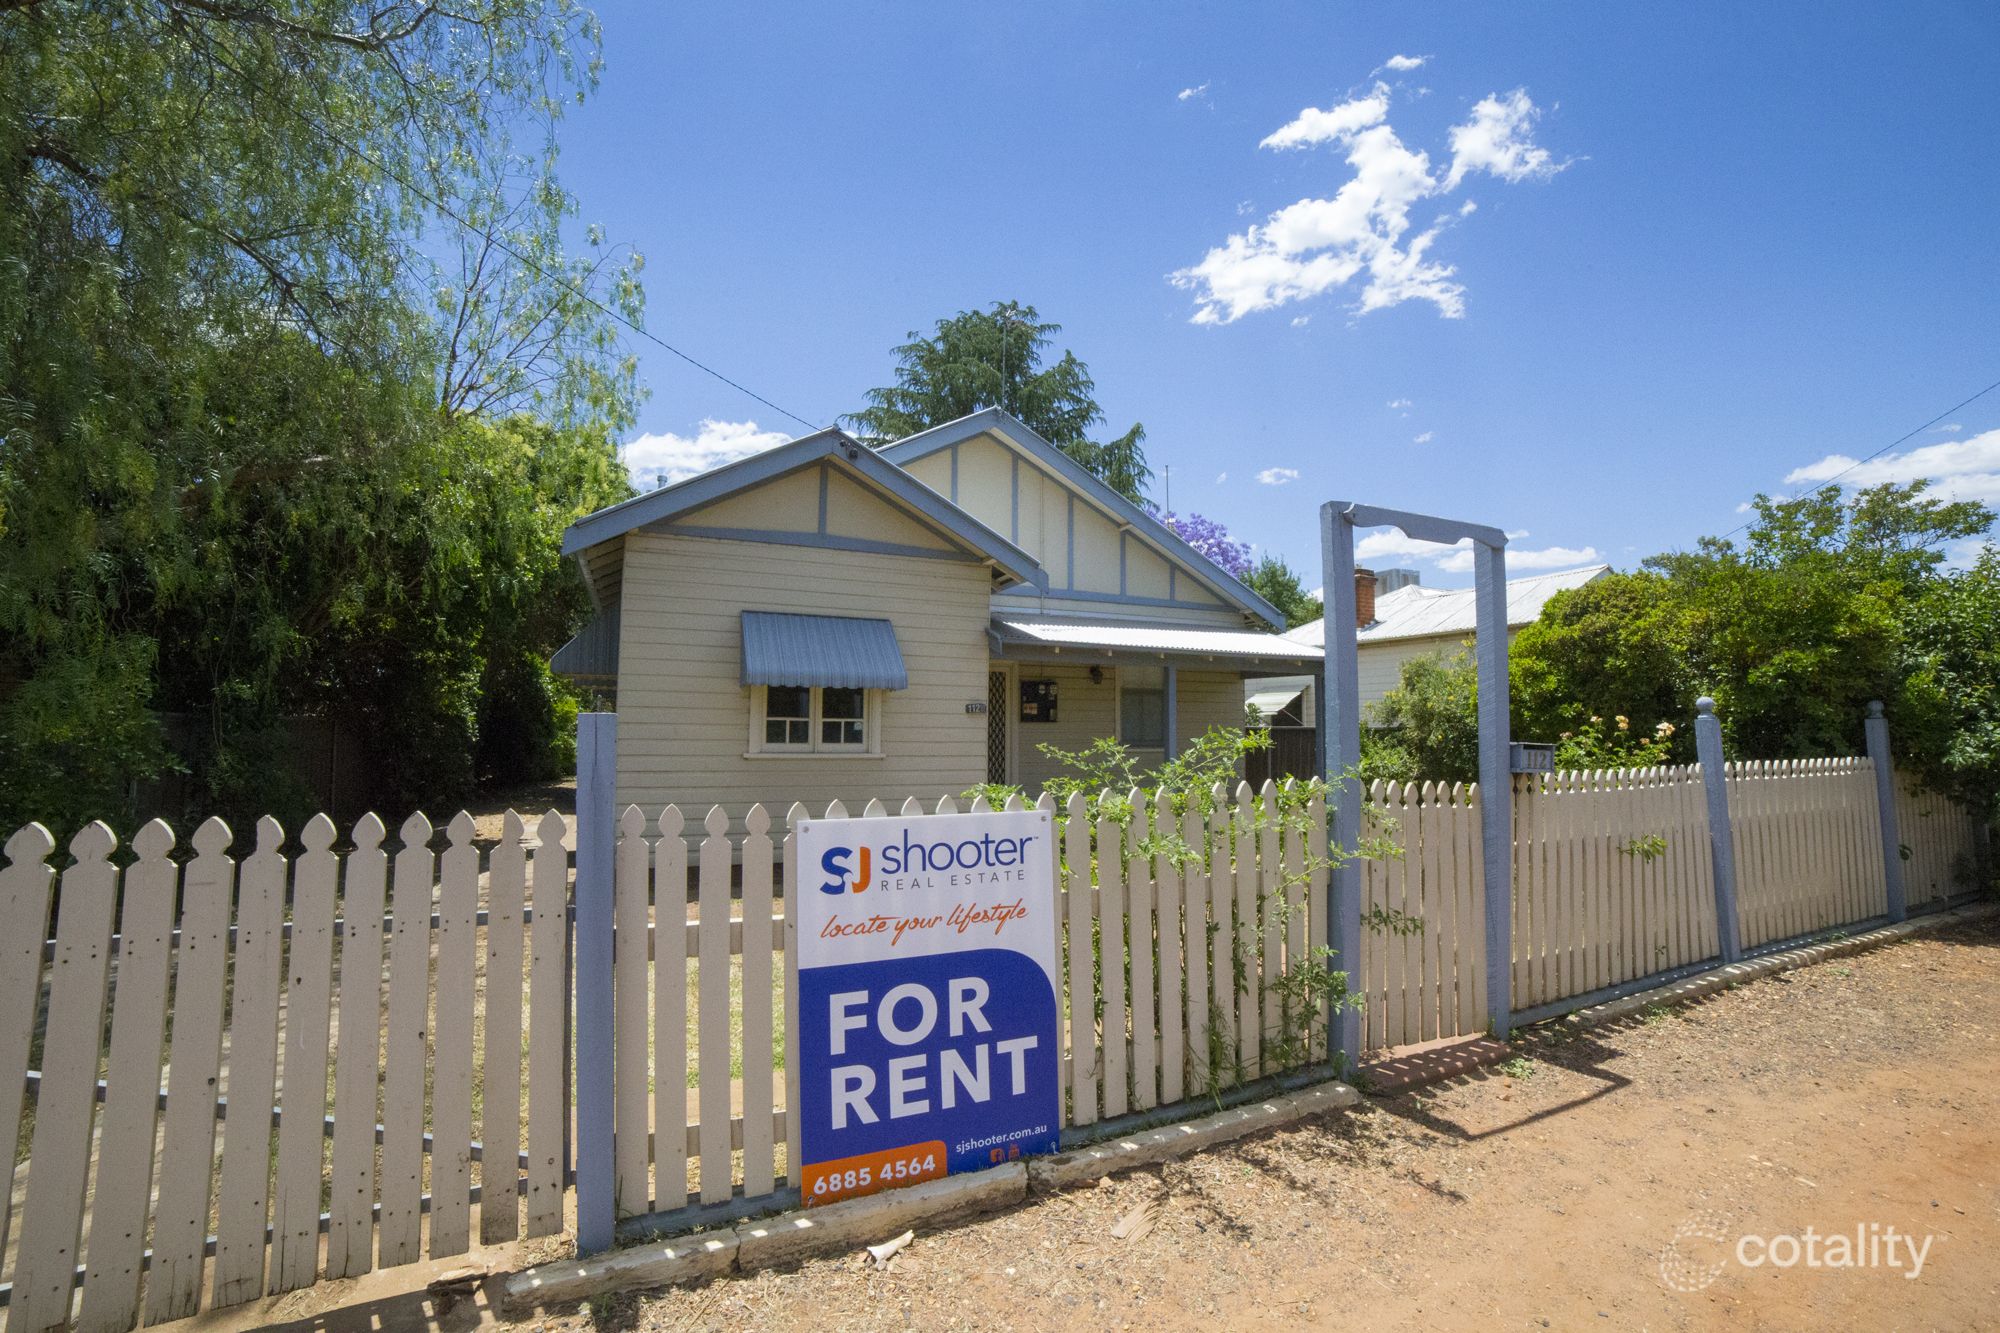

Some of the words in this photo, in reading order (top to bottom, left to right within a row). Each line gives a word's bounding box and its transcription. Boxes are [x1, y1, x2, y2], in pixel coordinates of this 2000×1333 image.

[1527, 751, 1547, 769] 112
[819, 846, 871, 895] SJ
[880, 877, 935, 892] REAL
[951, 869, 1025, 886] ESTATE
[820, 914, 901, 939] locate
[894, 914, 942, 947] your
[946, 898, 1029, 936] lifestyle
[829, 976, 993, 1056] FOR
[830, 1035, 1038, 1131] RENT
[956, 1125, 1048, 1155] sjshooter.com.au
[813, 1167, 872, 1195] 6885
[880, 1154, 936, 1181] 4564
